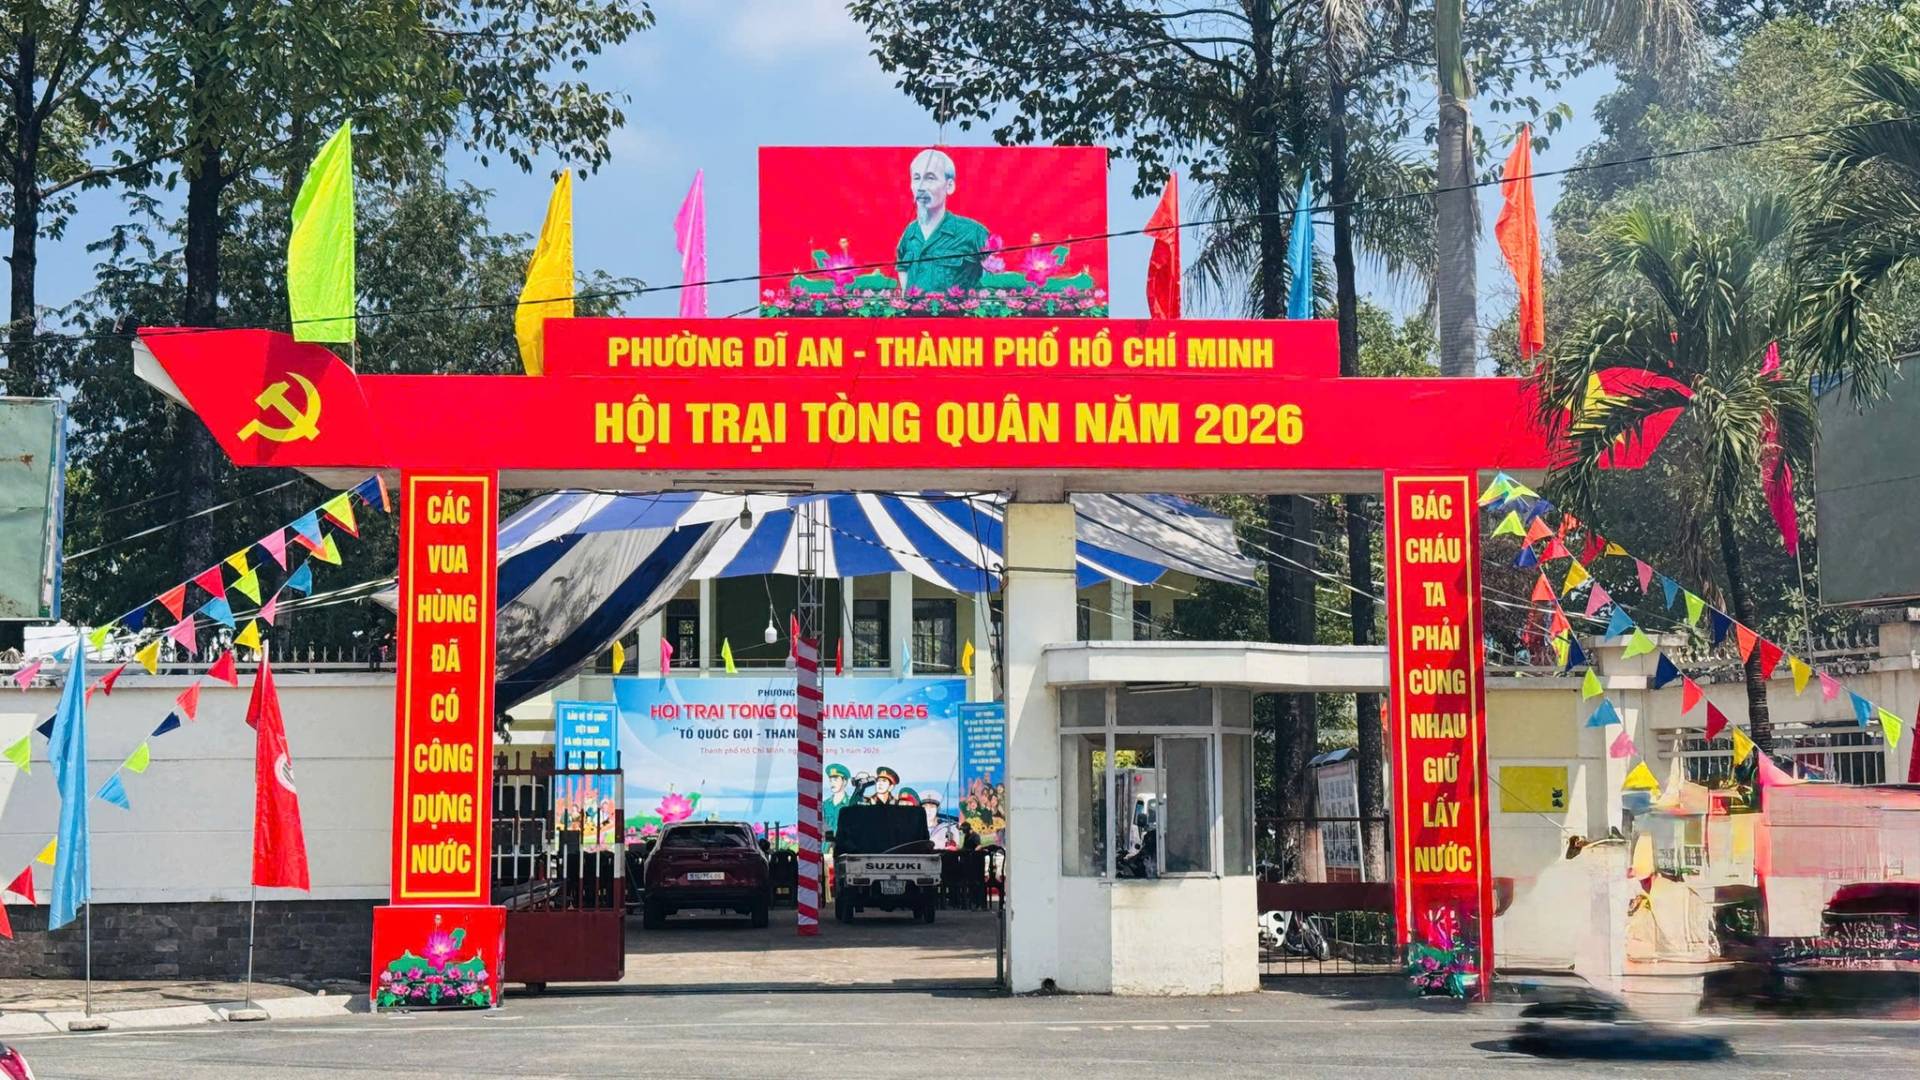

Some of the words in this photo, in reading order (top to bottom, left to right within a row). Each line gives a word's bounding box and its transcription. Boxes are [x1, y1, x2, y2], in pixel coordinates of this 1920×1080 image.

[608, 330, 743, 367] PHƯỜNG
[754, 331, 787, 367] DĨ
[797, 338, 842, 367] AN
[854, 350, 866, 358] -
[876, 330, 983, 367] THÀNH
[994, 327, 1059, 367] PHỐ
[1070, 327, 1113, 367] HỒ
[1123, 332, 1176, 367] CHÍ
[1187, 338, 1273, 368] MINH
[595, 394, 671, 453] HỘI
[686, 402, 786, 453] TRẠI
[802, 392, 921, 443] TÒNG
[937, 394, 1059, 448] QUÂN
[1076, 394, 1179, 443] NĂM
[1194, 403, 1304, 444] 2026
[427, 490, 470, 524] CÁC
[1411, 490, 1452, 520] BÁC
[428, 545, 469, 573] VUA
[1405, 532, 1460, 563] CHÁU
[418, 588, 476, 622] HÙNG
[1423, 582, 1446, 606] TA
[1411, 617, 1460, 650] PHẢI
[431, 638, 460, 672] ĐÃ
[1409, 664, 1465, 694] CÙNG
[430, 688, 459, 722] CÓ
[650, 701, 680, 721] HỘI
[682, 703, 724, 721] TRẠI
[832, 701, 873, 720] NĂM
[877, 704, 928, 720] 2026
[697, 725, 729, 740] QUỐC
[733, 729, 752, 741] GỌI
[1411, 713, 1466, 738] NHAU
[414, 738, 473, 773] CÔNG
[1423, 752, 1459, 783] GIỮ
[413, 791, 472, 829] DỰNG
[1423, 793, 1460, 828] LẤY
[411, 839, 471, 874] NƯỚC
[865, 862, 922, 870] SUZUKI
[1414, 841, 1472, 873] NƯỚC
